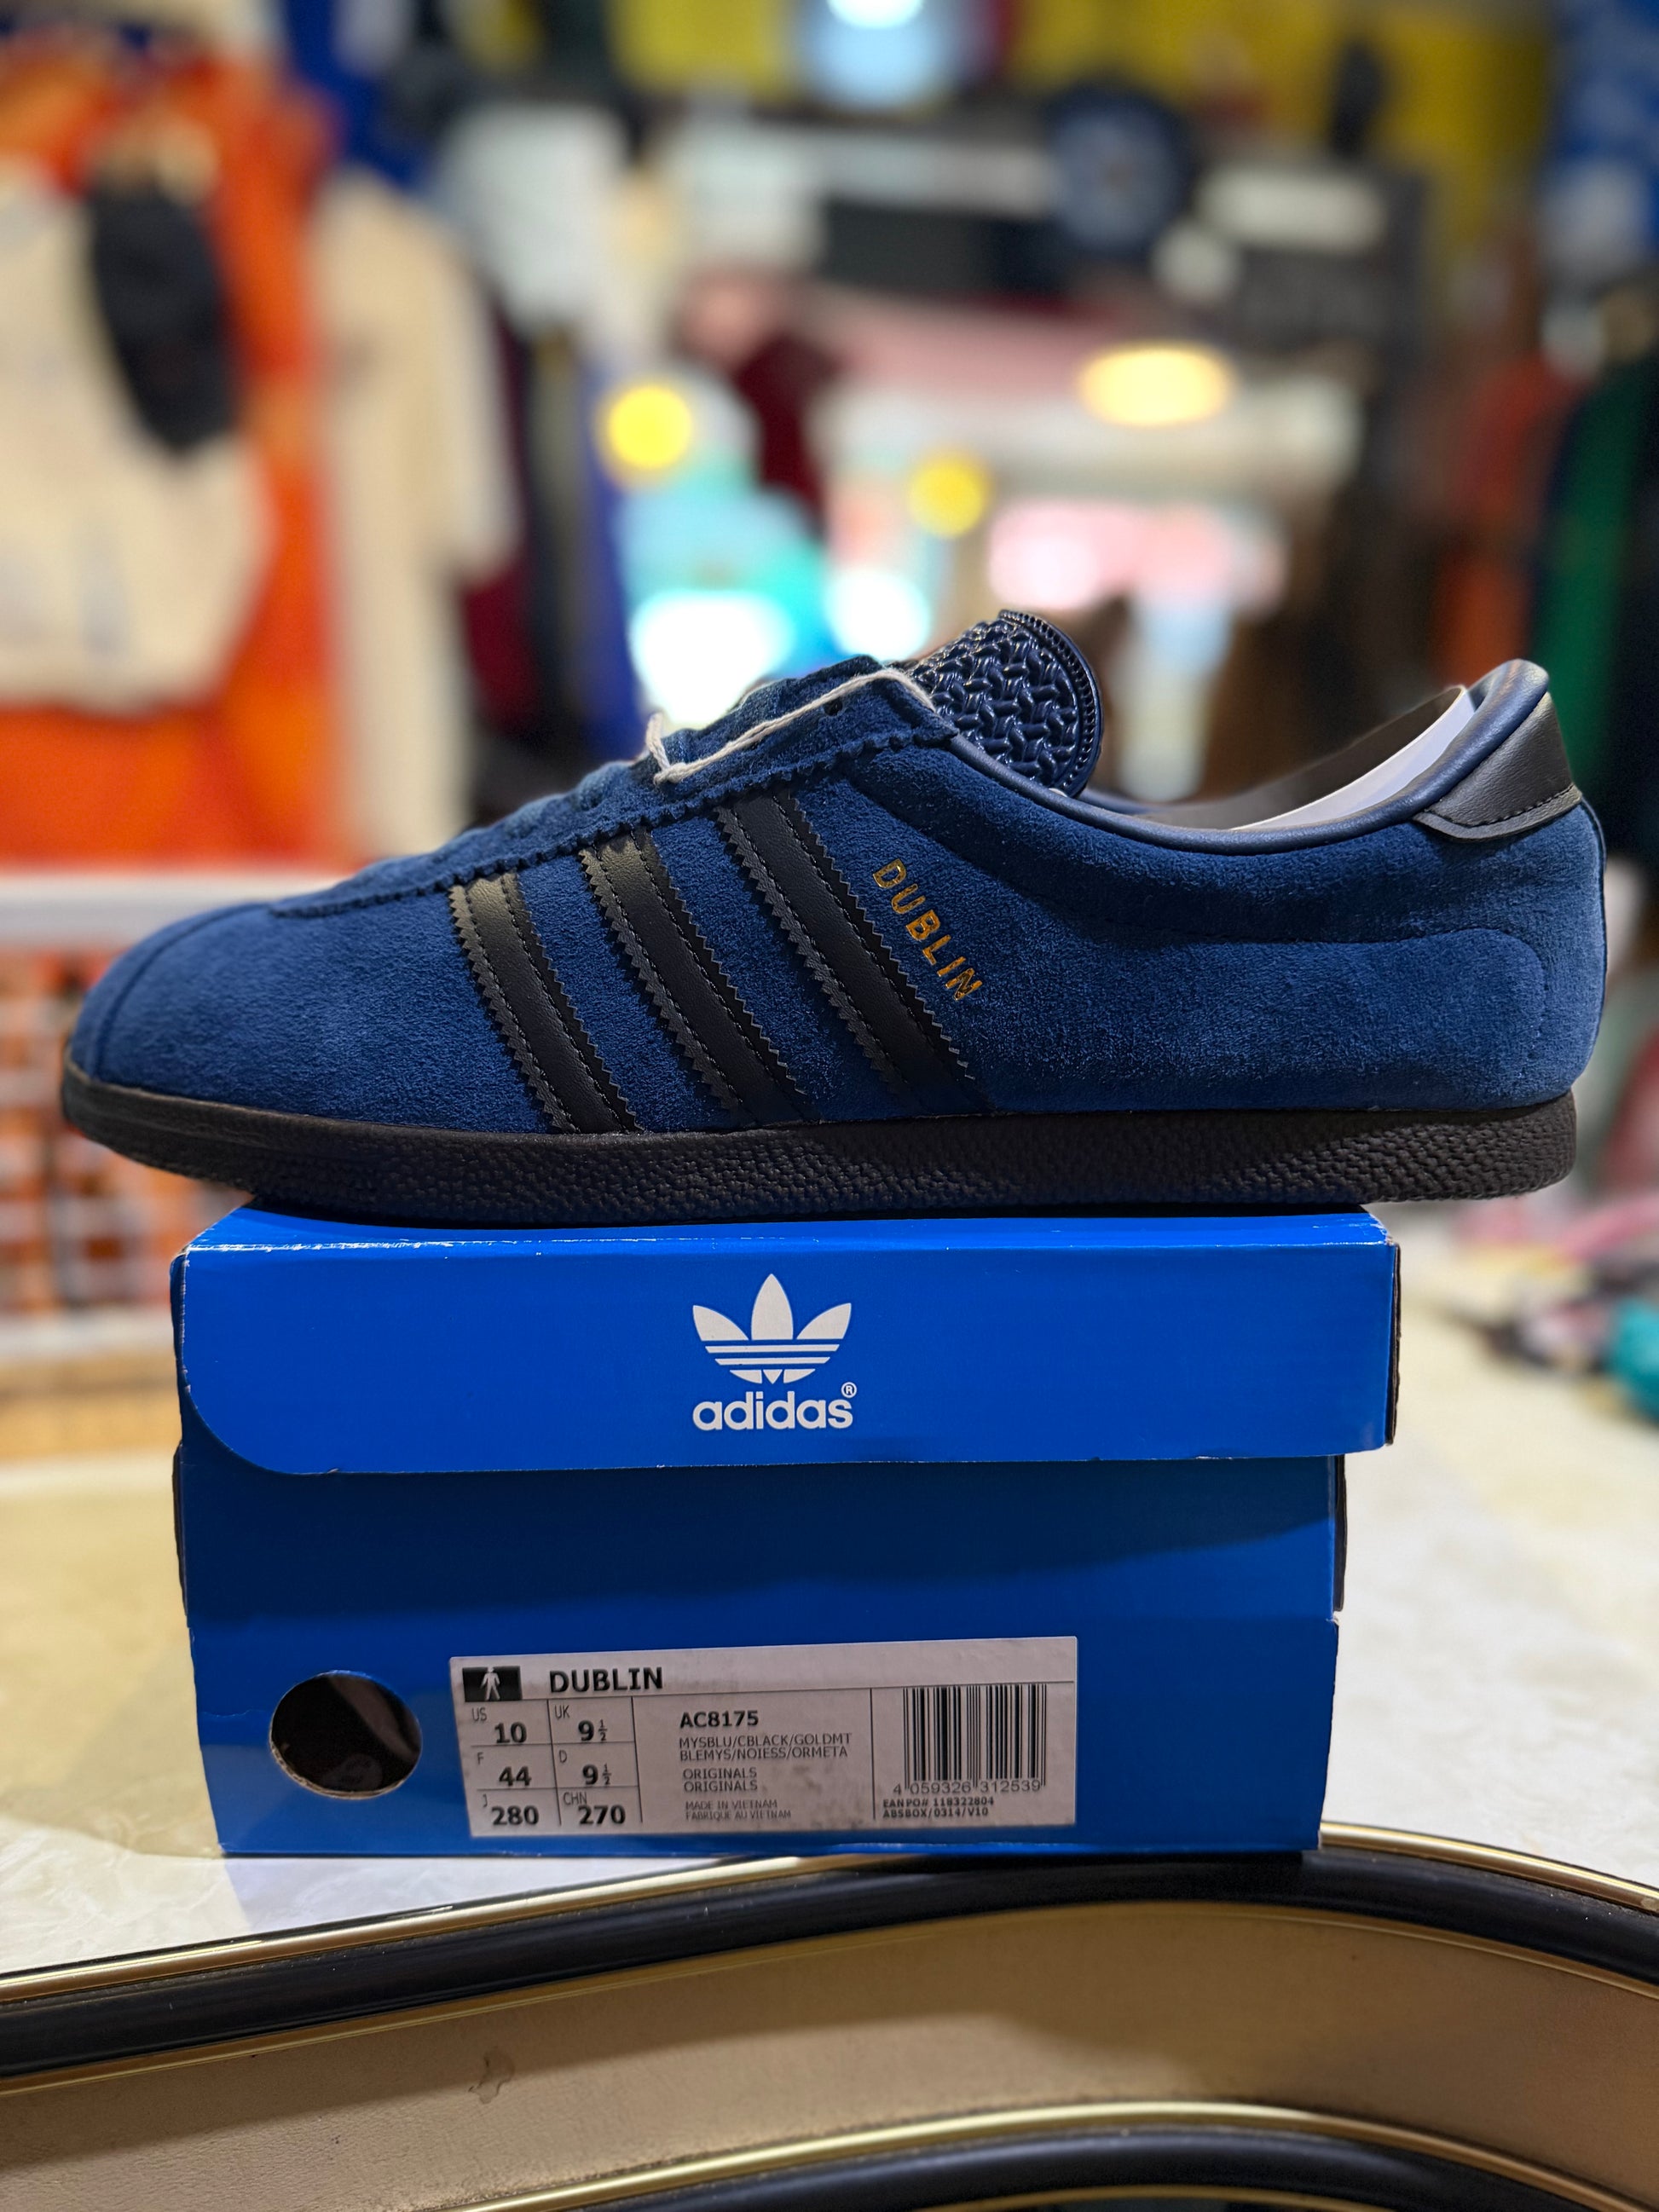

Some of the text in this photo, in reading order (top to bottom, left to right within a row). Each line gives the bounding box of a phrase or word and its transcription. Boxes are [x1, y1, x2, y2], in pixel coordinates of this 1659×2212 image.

[872, 858, 982, 1001] DUBLIN
[692, 1390, 853, 1431] adidas
[549, 1666, 663, 1693] DUBLIN
[471, 1707, 487, 1722] US
[554, 1705, 570, 1719] UK
[679, 1710, 759, 1729] AC8175
[494, 1721, 528, 1744] 10
[679, 1732, 853, 1748] MYSBLU/CBLACK/GOLDMT
[477, 1752, 484, 1764] F
[558, 1750, 568, 1764] D
[679, 1746, 848, 1762] BLEMYS/NOIESS/ORMETA
[499, 1765, 532, 1787] 44
[683, 1767, 758, 1780] ORIGINALS
[684, 1779, 759, 1793] ORIGINALS
[893, 1779, 1042, 1796] 4 059326 312539
[483, 1793, 488, 1807] J
[564, 1792, 587, 1806] CHN
[685, 1799, 778, 1811] MADE IN VIETNAM
[882, 1799, 905, 1808] EAN
[906, 1798, 929, 1808] PO#
[491, 1805, 540, 1826] 280
[577, 1805, 627, 1826] 270
[685, 1811, 792, 1821] FABRIQUE AU VIETNAM
